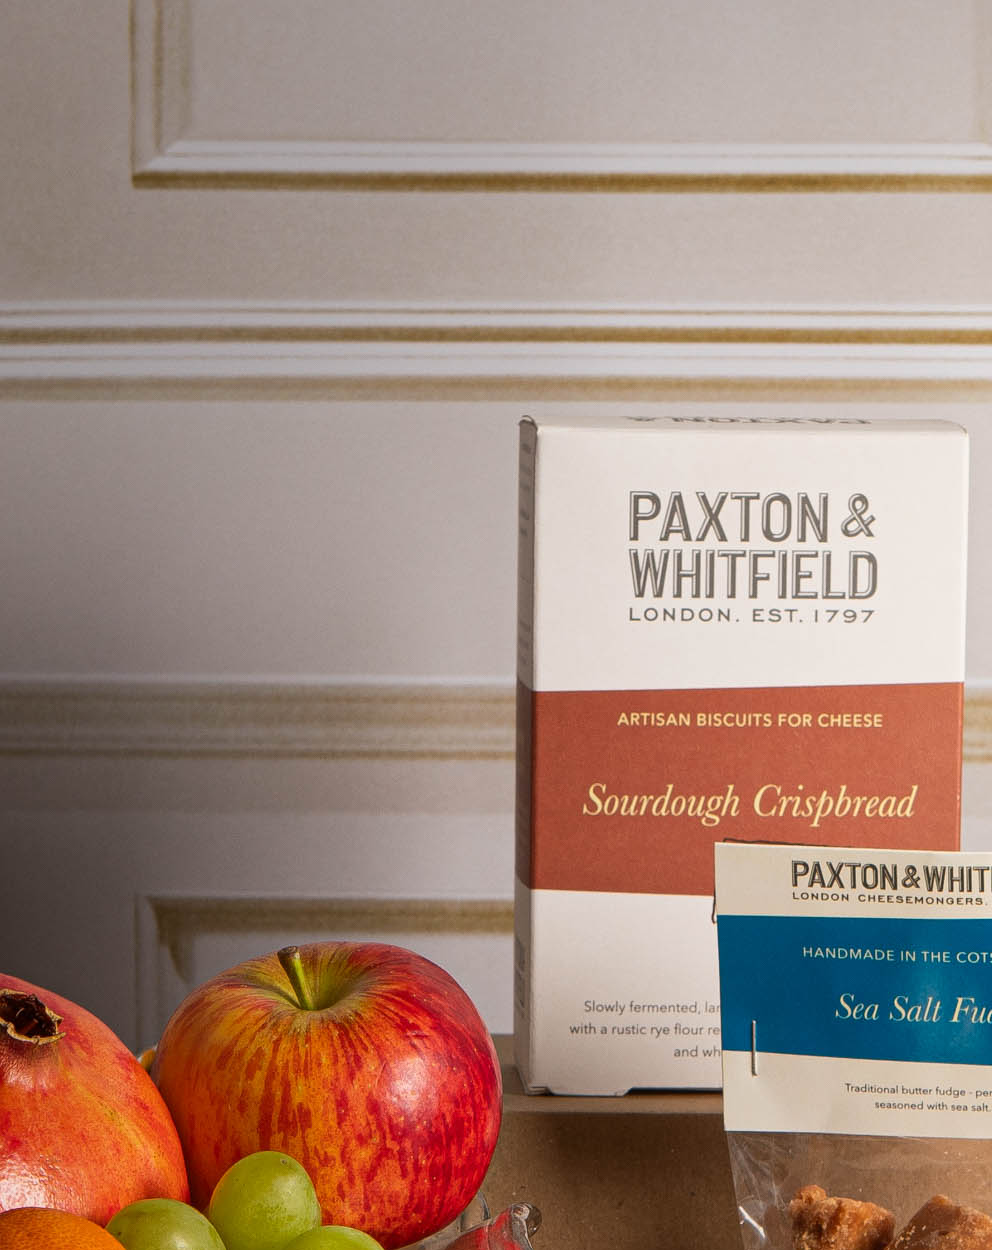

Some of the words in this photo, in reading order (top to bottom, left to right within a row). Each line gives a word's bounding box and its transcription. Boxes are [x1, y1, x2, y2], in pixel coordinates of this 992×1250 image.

[629, 491, 828, 542] PAXTON
[841, 493, 876, 538] &
[629, 549, 878, 599] WHITFIELD
[629, 607, 739, 623] LONDON.
[752, 608, 803, 623] EST.
[815, 609, 874, 624] 1797
[617, 712, 691, 727] ARTISAN
[697, 713, 772, 727] BISCUITS
[778, 713, 812, 727] FOR
[818, 713, 883, 728] CHEESE
[583, 783, 740, 827] Sourdough
[753, 784, 918, 828] Crispbread
[792, 891, 850, 902] LONDON
[803, 946, 895, 961] HANDMADE
[900, 950, 917, 963] IN
[921, 951, 951, 963] THE
[584, 1000, 625, 1015] Slowly
[630, 1000, 701, 1015] fermented,
[835, 993, 879, 1021] Sea
[889, 995, 941, 1023] Salt
[570, 1023, 596, 1035] with
[600, 1026, 607, 1035] a
[612, 1023, 647, 1035] rustic
[650, 1027, 669, 1039] rye
[674, 1023, 703, 1036] flour
[674, 1046, 698, 1058] and
[845, 1082, 899, 1095] Traditional
[901, 1085, 932, 1097] butter
[935, 1086, 966, 1099] fudge
[874, 1100, 924, 1111] seasoned
[927, 1101, 948, 1112] with
[951, 1104, 969, 1112] sea
[971, 1103, 991, 1113] salt.
